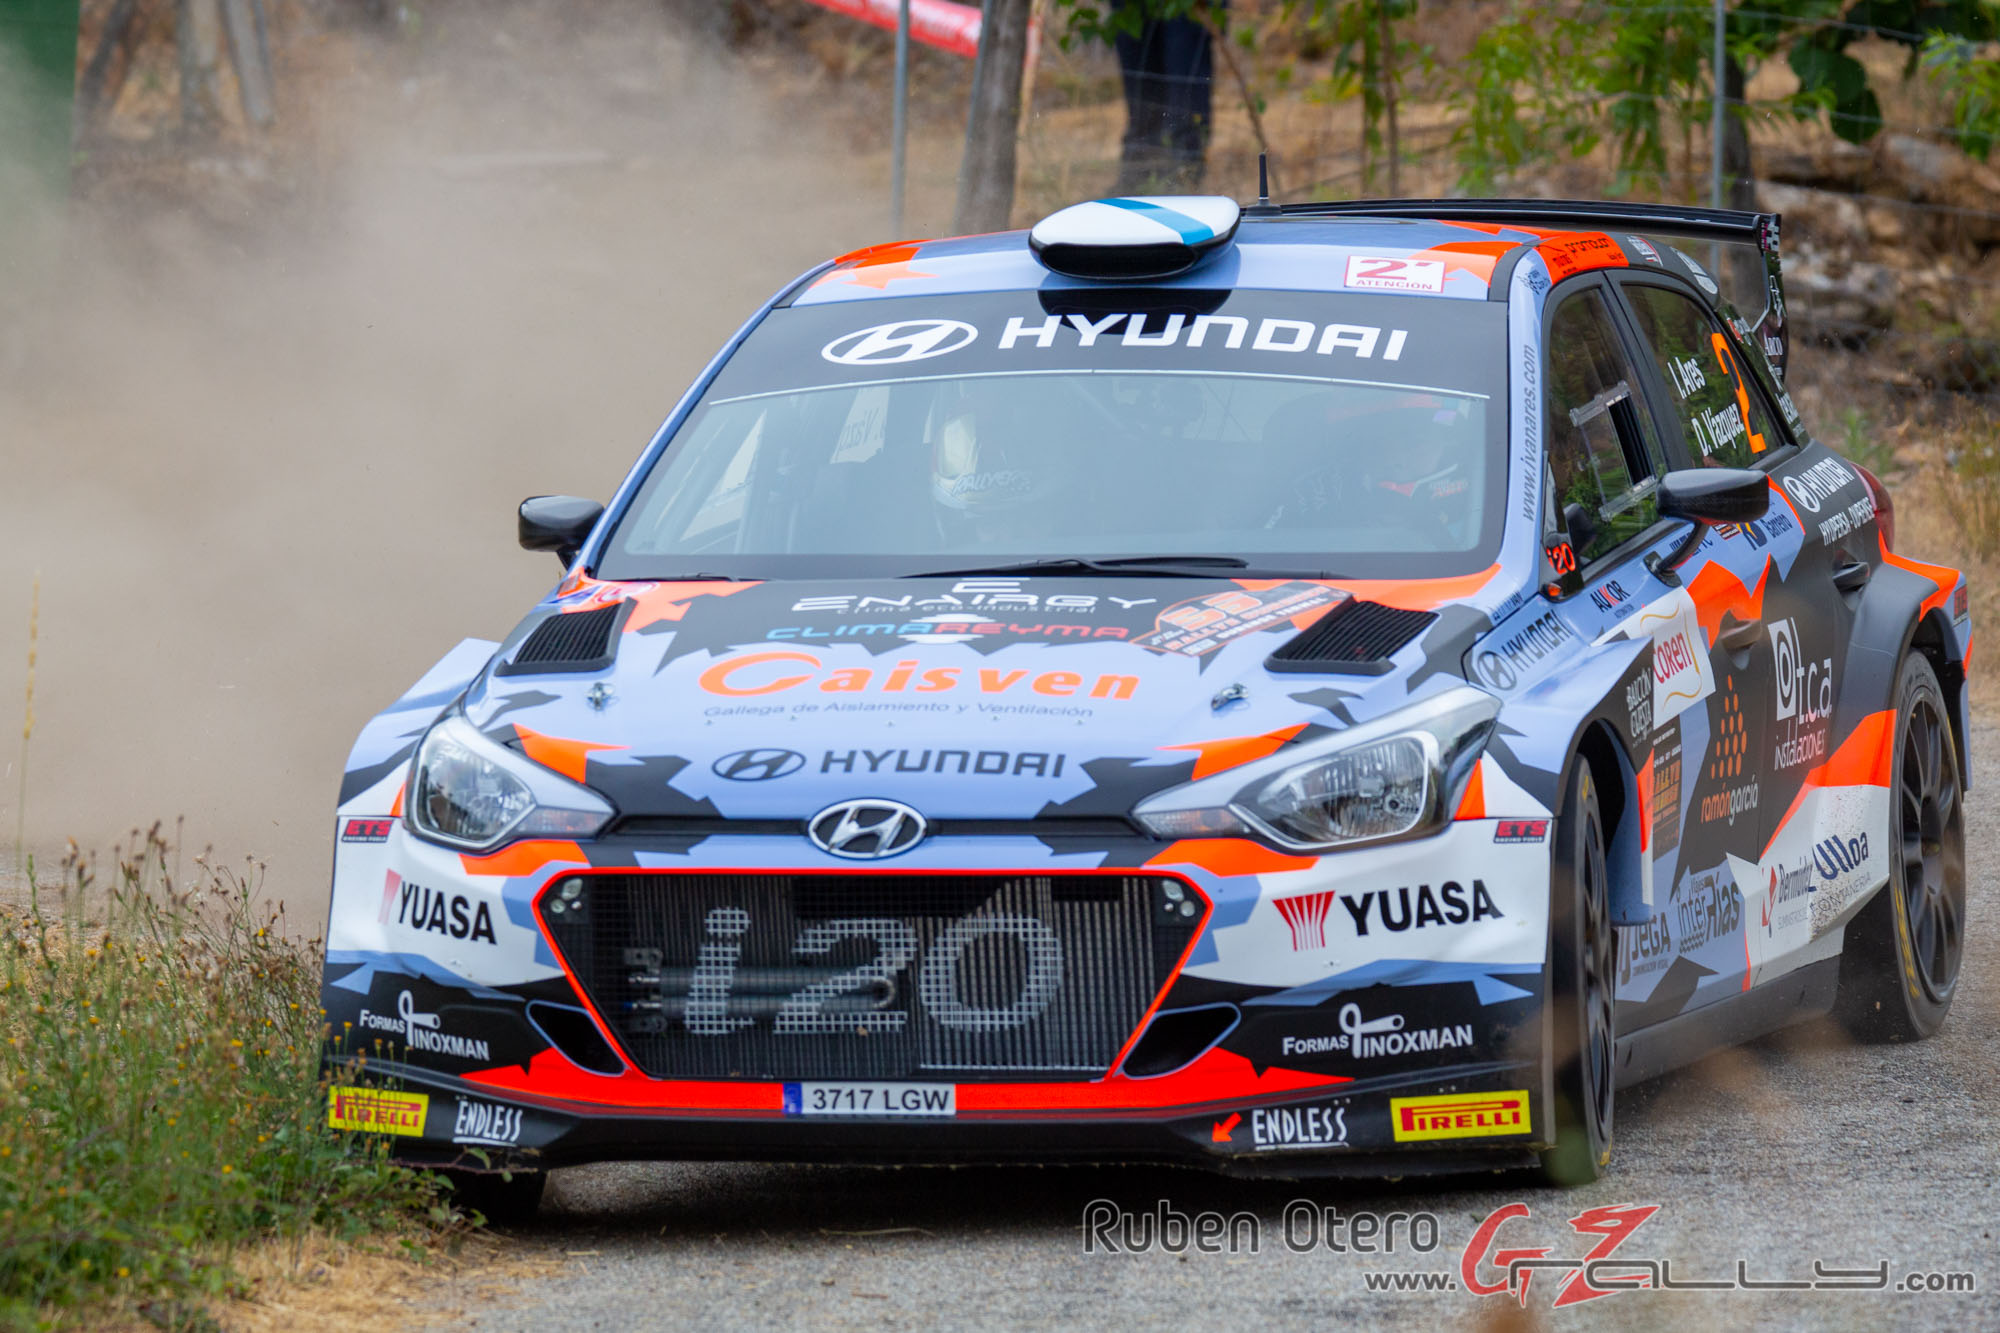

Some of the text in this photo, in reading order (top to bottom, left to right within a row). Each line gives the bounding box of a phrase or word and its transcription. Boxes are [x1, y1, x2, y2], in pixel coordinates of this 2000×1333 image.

[998, 314, 1408, 361] HYUNDAI
[1522, 344, 1538, 522] www.ivanares.com
[1799, 456, 1855, 500] HYUNDAI
[1590, 580, 1631, 613] AUKOR
[1501, 609, 1574, 672] HYUNDAI
[703, 702, 1093, 717] Gallega de Aislamiento y Ventilación
[820, 749, 1066, 779] HYUNDAI
[346, 820, 393, 836] ETS
[1497, 821, 1549, 837] ETS
[1813, 831, 1869, 880] Ulloa
[398, 880, 498, 946] YUASA
[1340, 879, 1505, 936] YUASA
[685, 907, 1063, 1035] i20
[414, 1032, 490, 1062] INOXMAN
[1362, 1024, 1473, 1057] INOXMAN
[335, 1093, 421, 1130] PIRELLI
[813, 1089, 949, 1111] 3717 LGW
[1401, 1099, 1522, 1132] PIRELLI
[455, 1100, 524, 1141] ENDLESS
[1252, 1106, 1348, 1144] ENDLESS
